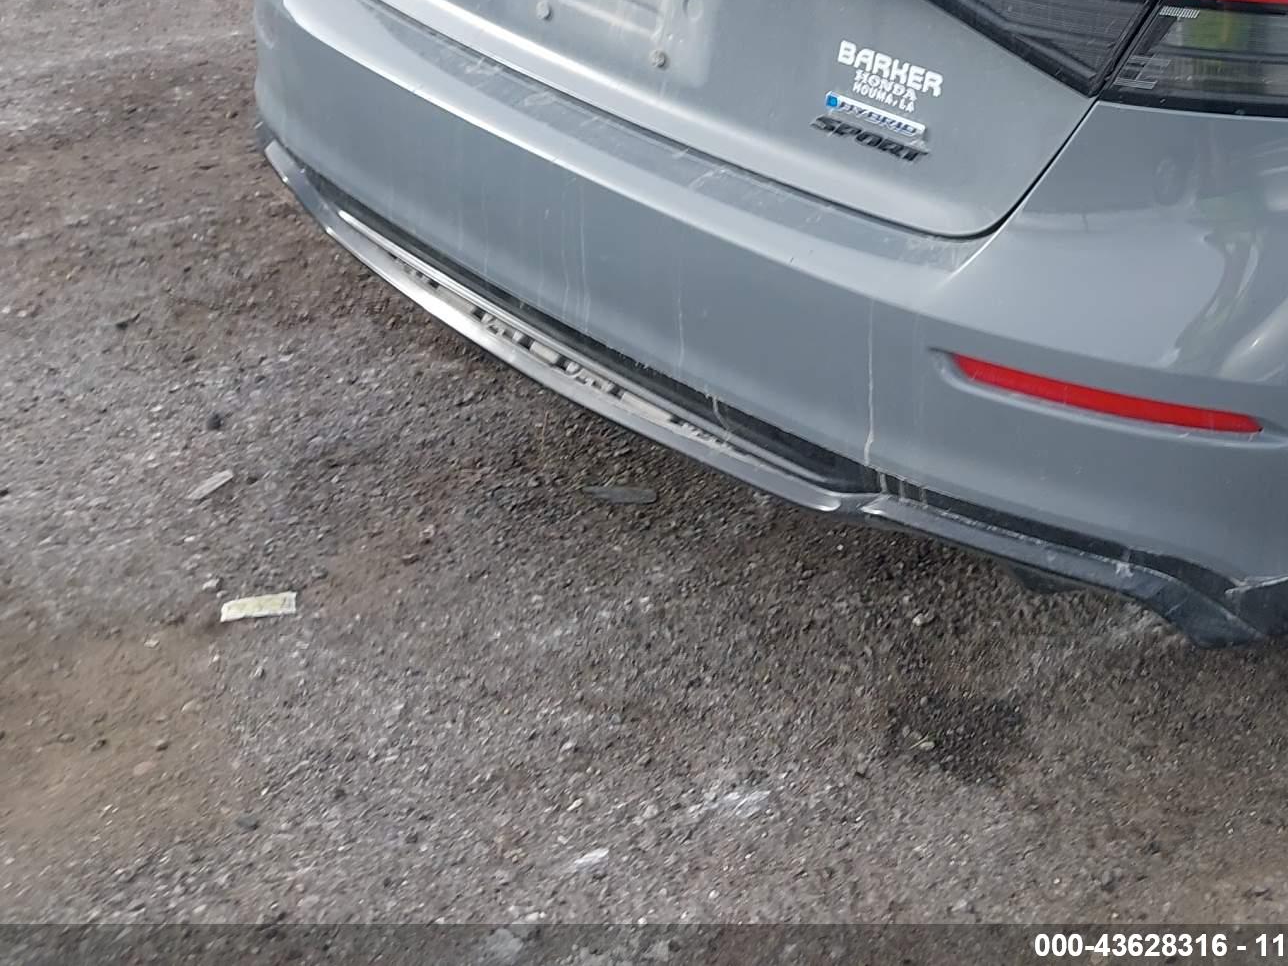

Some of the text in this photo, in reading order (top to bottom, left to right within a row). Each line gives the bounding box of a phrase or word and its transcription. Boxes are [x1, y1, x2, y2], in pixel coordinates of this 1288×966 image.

[837, 39, 944, 98] BARKER
[854, 69, 918, 102] HONDA
[811, 115, 930, 163] SPORT
[838, 99, 919, 138] HYBRID
